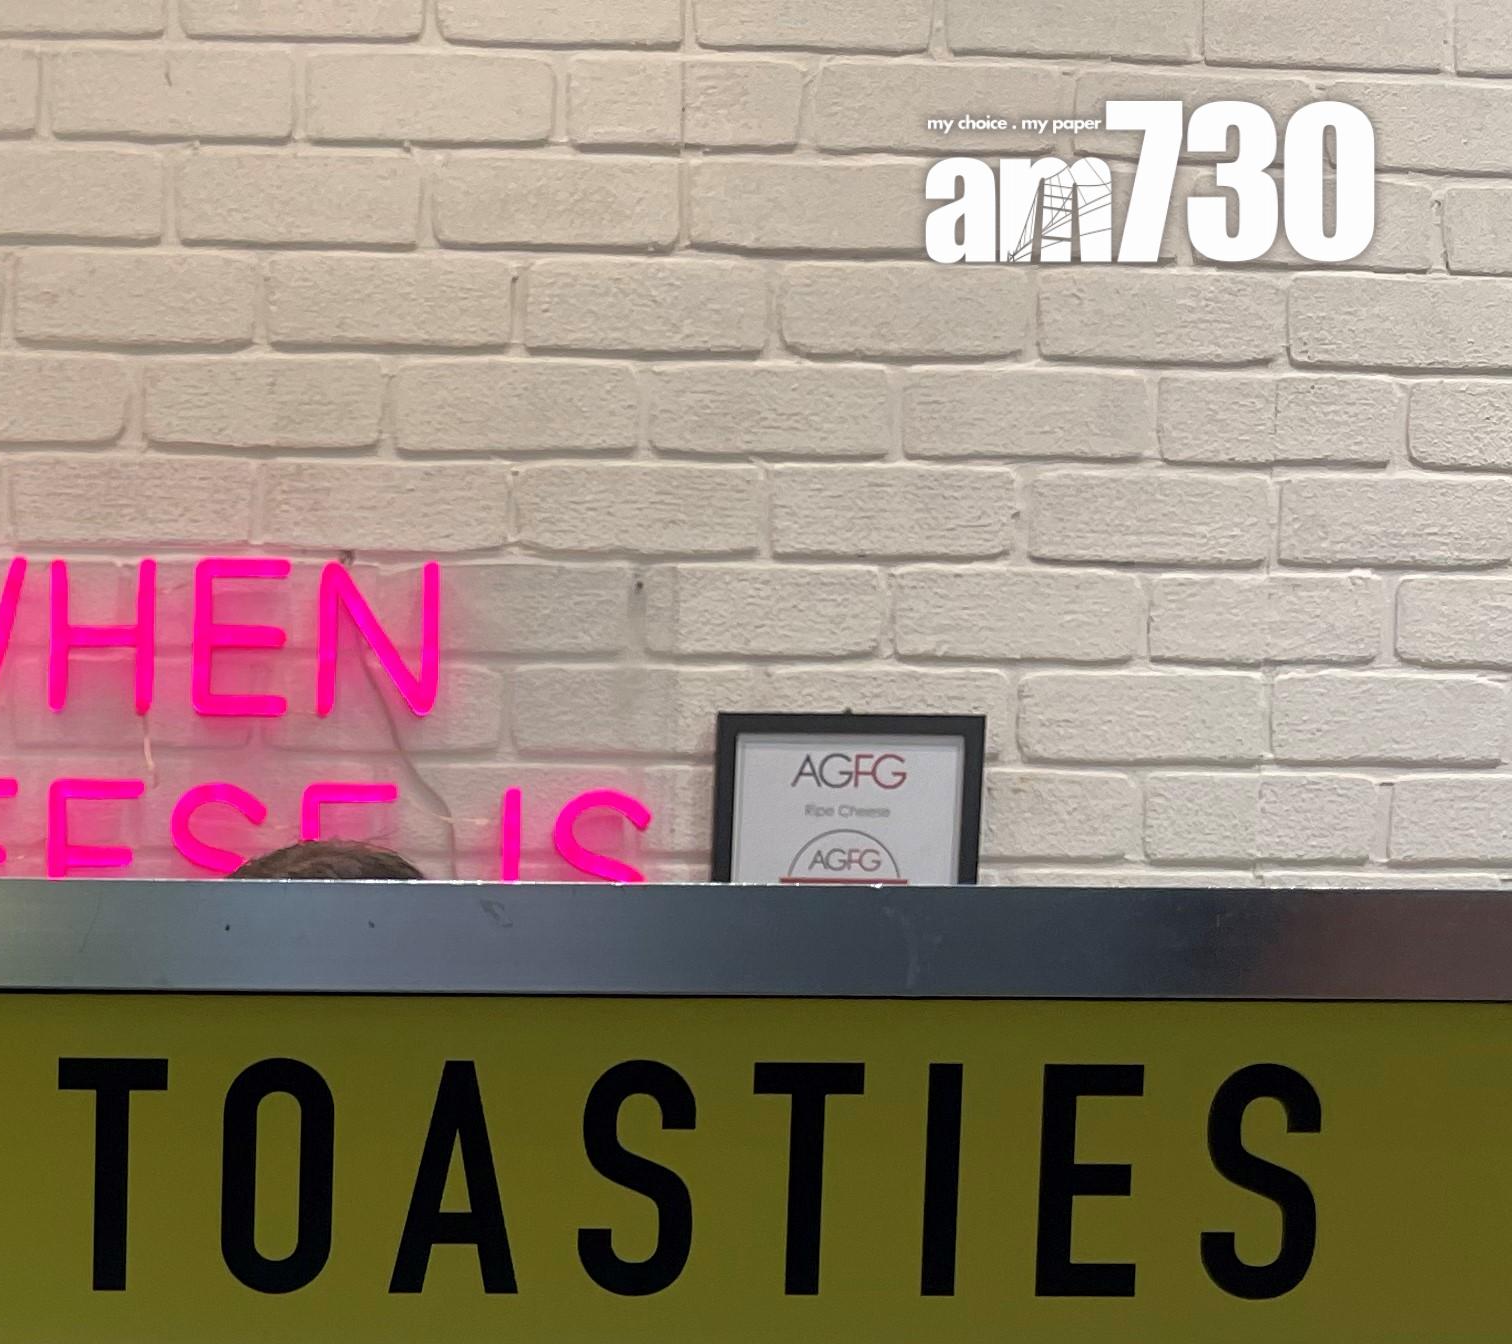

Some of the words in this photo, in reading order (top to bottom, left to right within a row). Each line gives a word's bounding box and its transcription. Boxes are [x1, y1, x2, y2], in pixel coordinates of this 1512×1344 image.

[791, 753, 907, 790] AGFG
[804, 805, 835, 818] Ripe
[837, 804, 891, 818] Cheese
[808, 848, 882, 872] AGFG
[56, 1057, 1323, 1301] TOASTIES
